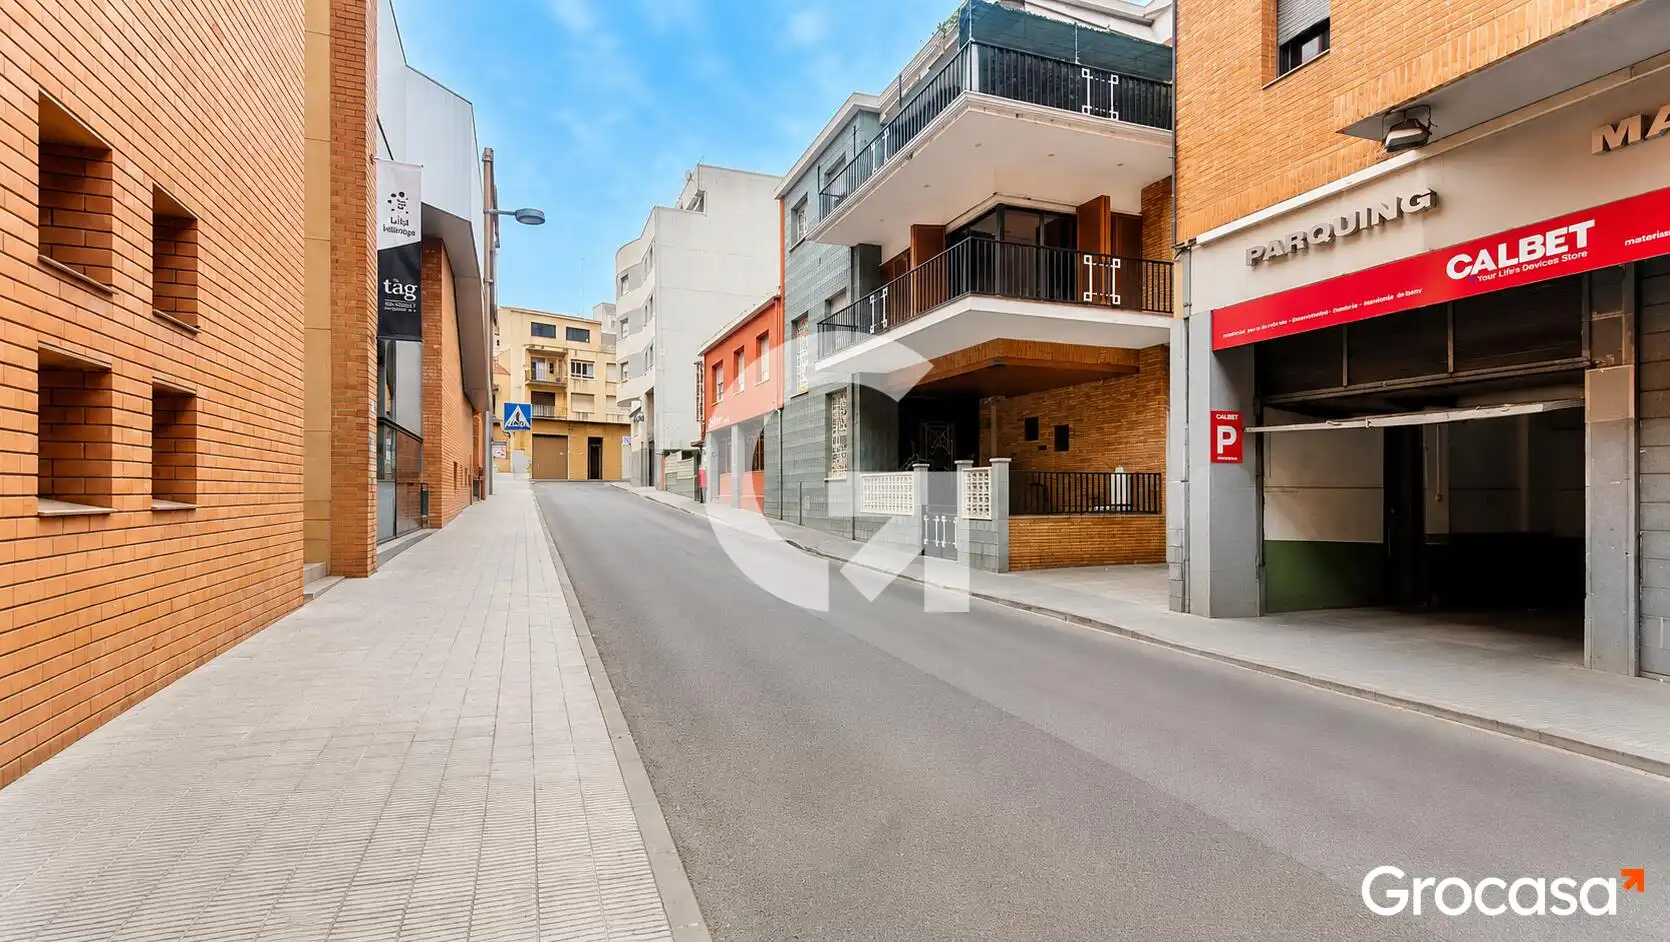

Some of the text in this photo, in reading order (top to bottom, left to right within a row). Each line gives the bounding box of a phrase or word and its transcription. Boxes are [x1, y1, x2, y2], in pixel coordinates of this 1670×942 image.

[1246, 188, 1435, 266] PARQUING
[1446, 219, 1596, 280] CALBET
[1477, 272, 1497, 282] Your
[1561, 250, 1588, 262] Store
[383, 278, 418, 301] tàg
[1217, 425, 1237, 454] P
